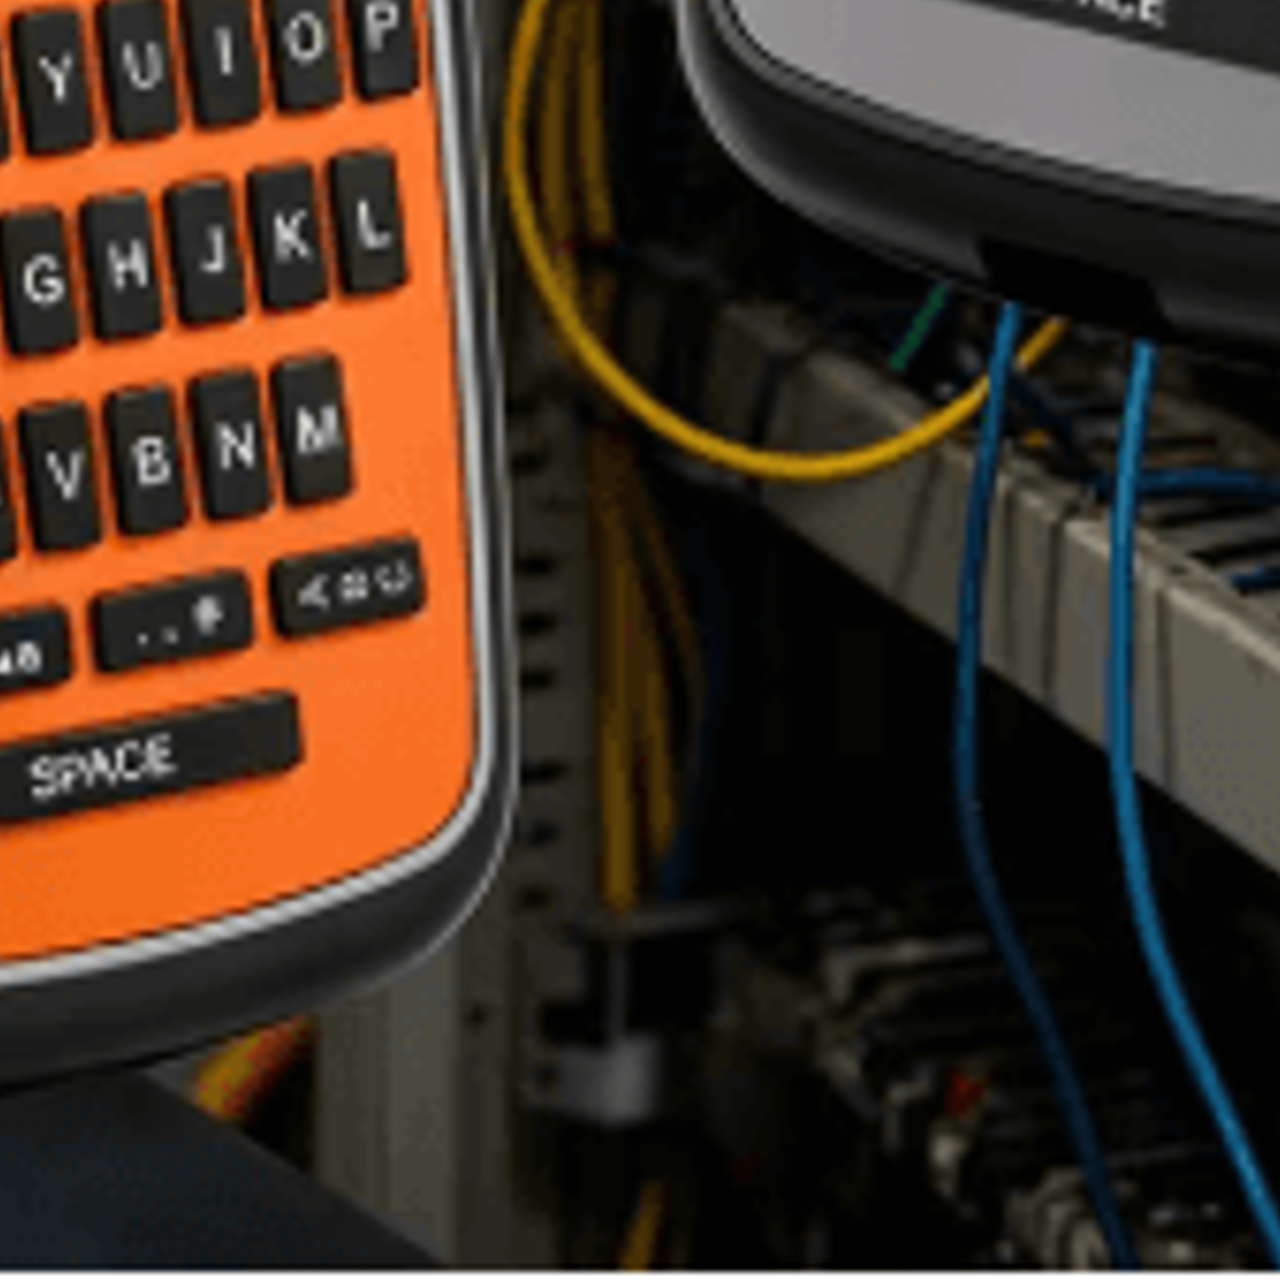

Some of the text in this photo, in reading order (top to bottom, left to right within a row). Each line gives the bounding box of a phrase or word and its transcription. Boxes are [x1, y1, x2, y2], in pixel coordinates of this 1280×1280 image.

[37, 54, 74, 102] Y
[120, 40, 164, 92] U
[216, 27, 234, 77] I
[283, 9, 327, 65] O
[22, 253, 66, 305] G
[106, 238, 150, 290] H
[201, 226, 227, 275] J
[272, 209, 311, 259] K
[355, 198, 391, 250] L
[44, 450, 84, 502] V
[131, 434, 172, 487] B
[217, 422, 256, 470] N
[296, 405, 339, 454] M
[29, 733, 175, 799] SPACE
